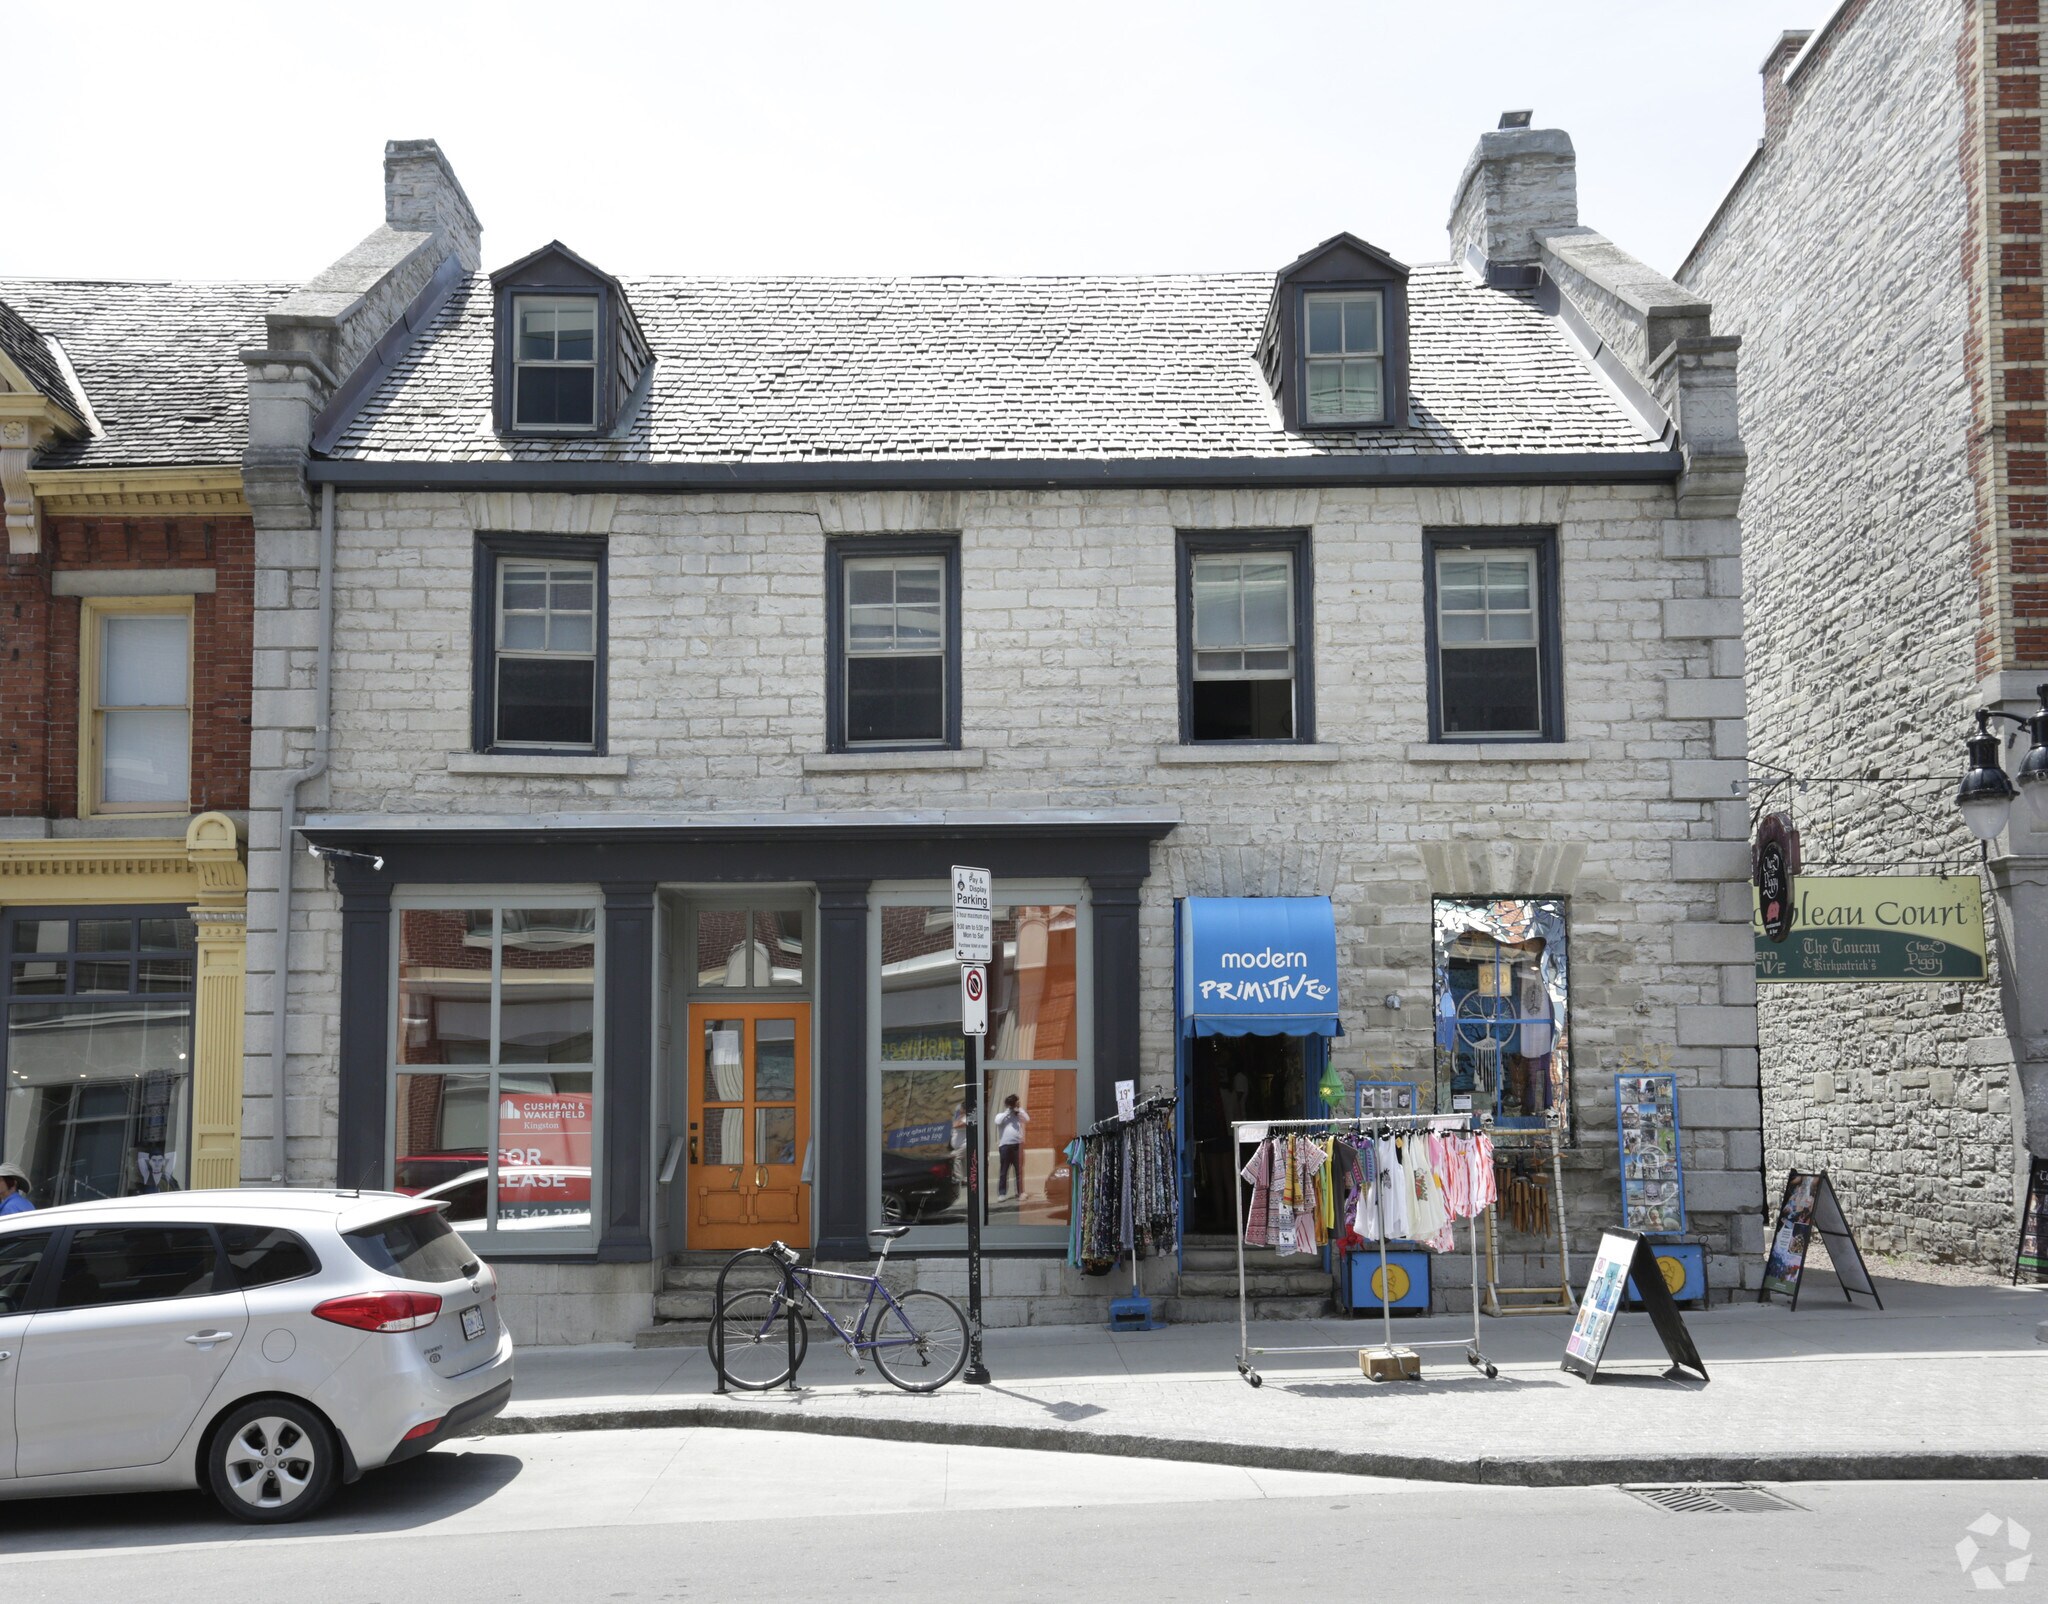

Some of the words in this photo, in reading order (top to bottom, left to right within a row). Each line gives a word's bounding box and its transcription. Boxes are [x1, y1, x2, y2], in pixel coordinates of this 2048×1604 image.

[969, 875, 978, 884] Pay
[969, 885, 987, 894] Display
[957, 893, 988, 908] Parking
[1753, 890, 1865, 926] oleau
[1875, 901, 1968, 926] Court
[1803, 937, 1828, 955] The
[1832, 937, 1881, 954] Toucan
[1221, 947, 1308, 968] modern
[1907, 952, 1943, 975] Piggy
[1813, 958, 1878, 974] Kirkpatrick's
[523, 1102, 575, 1111] CUSHMAN
[577, 1102, 585, 1110] &
[523, 1110, 585, 1119] WAKEFIELD
[523, 1121, 560, 1130] Kingston
